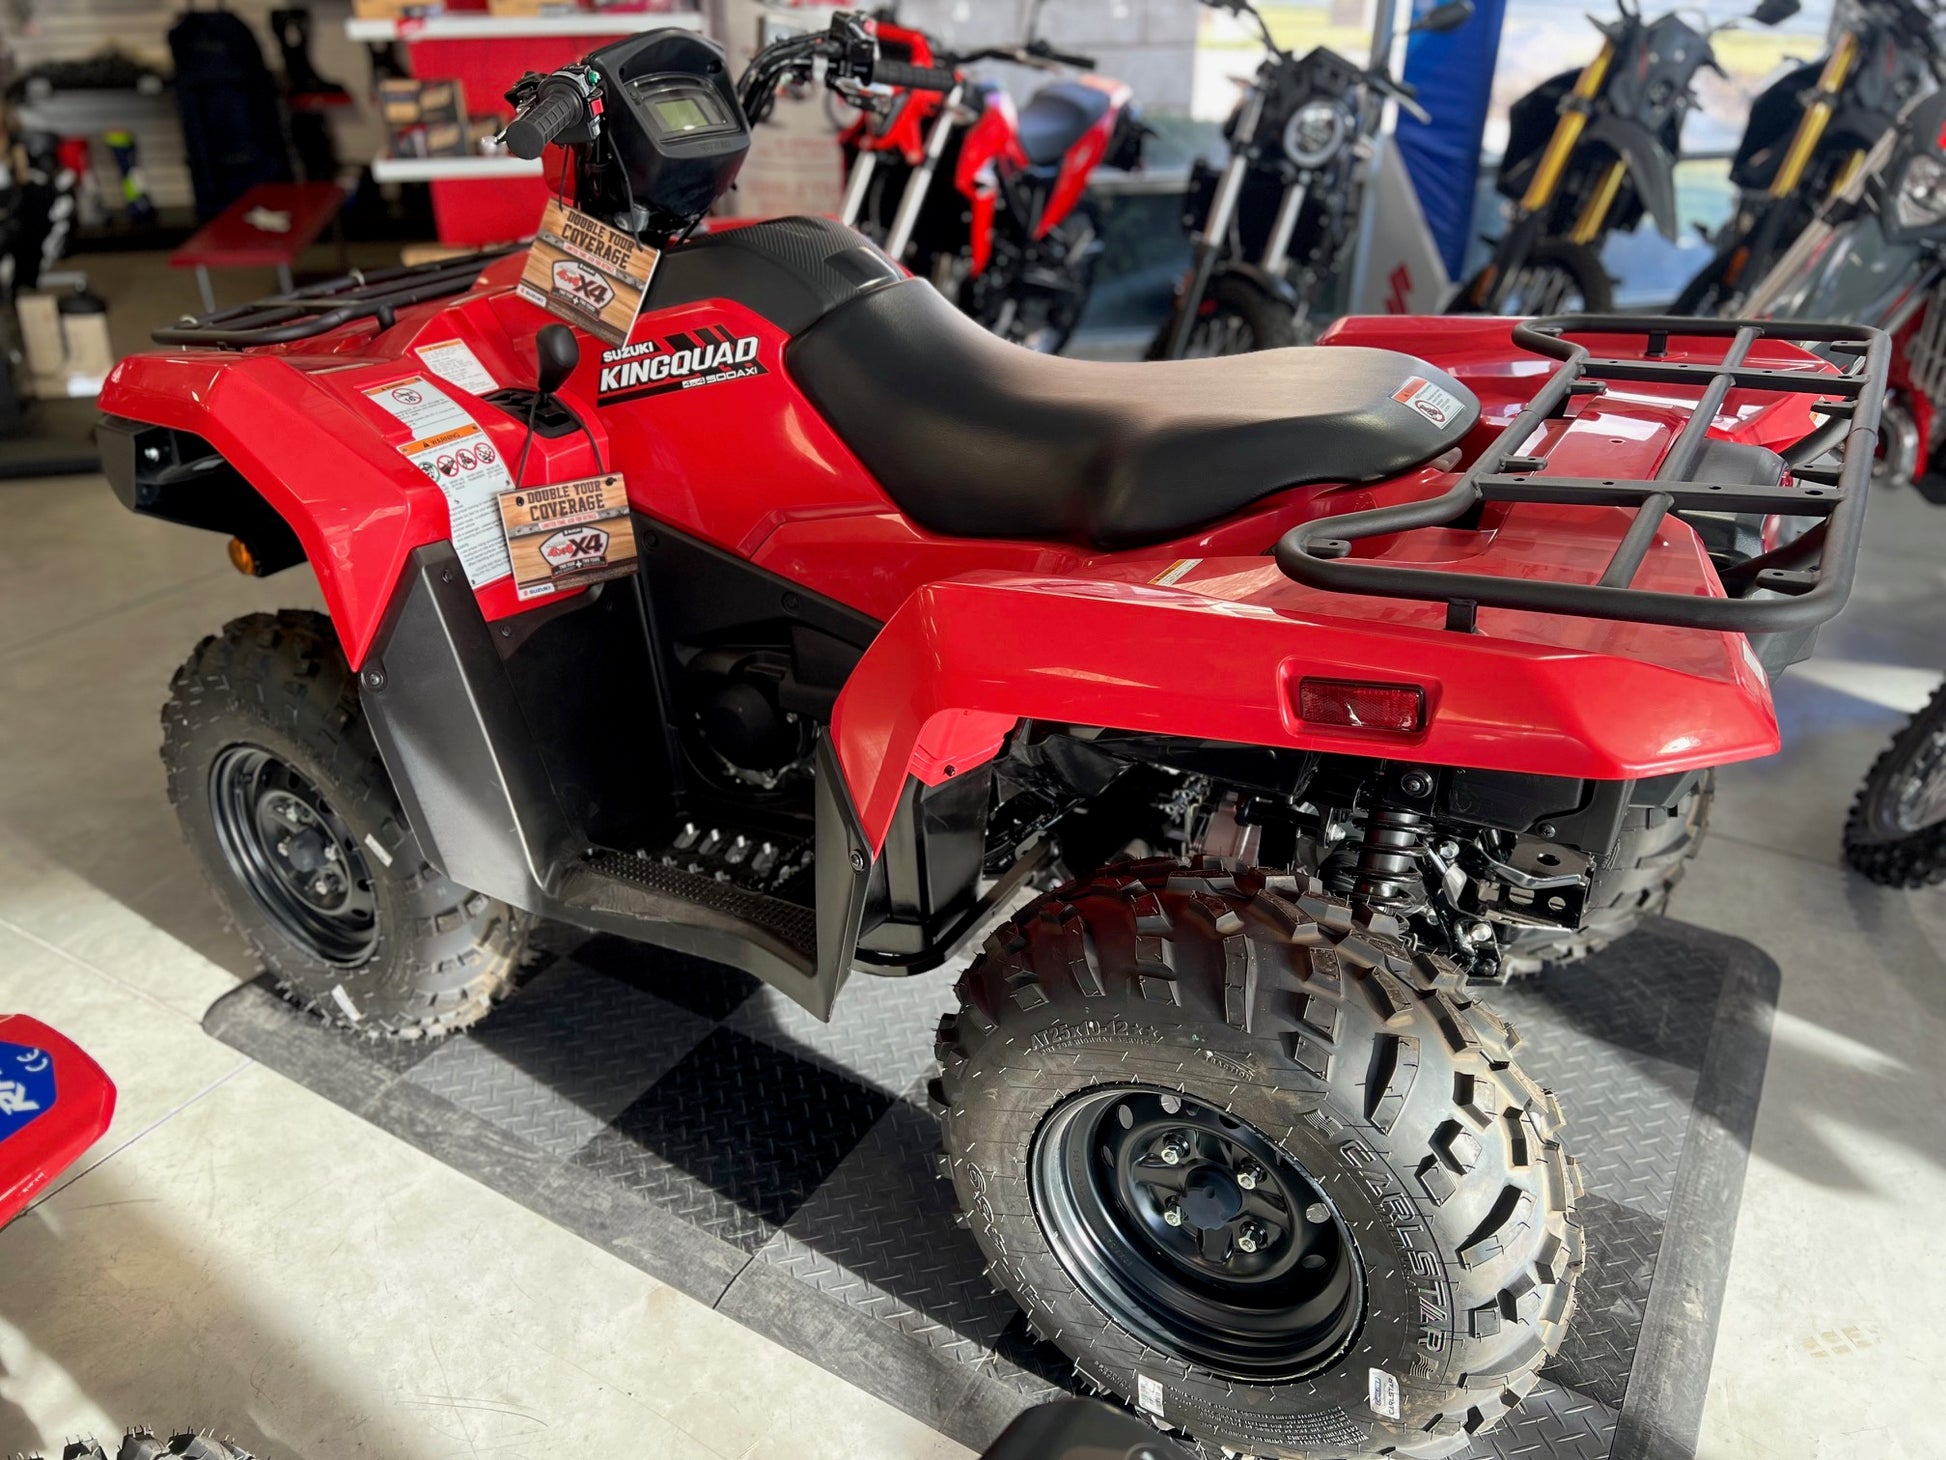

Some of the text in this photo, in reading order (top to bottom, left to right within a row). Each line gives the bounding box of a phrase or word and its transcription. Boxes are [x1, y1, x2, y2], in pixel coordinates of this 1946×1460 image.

[566, 210, 636, 253] DOUBLE YOUR
[561, 224, 631, 271] COVERAGE
[572, 274, 608, 306] X4
[599, 336, 759, 393] KINGQUAD
[602, 341, 655, 363] SUZUKI
[431, 432, 461, 446] WARNING
[526, 480, 603, 504] DOUBLE YOUR
[529, 493, 605, 522] COVERAGE
[570, 533, 603, 558] X4
[529, 585, 551, 595] SUZUKI
[1339, 1138, 1448, 1353] CARLSTAR
